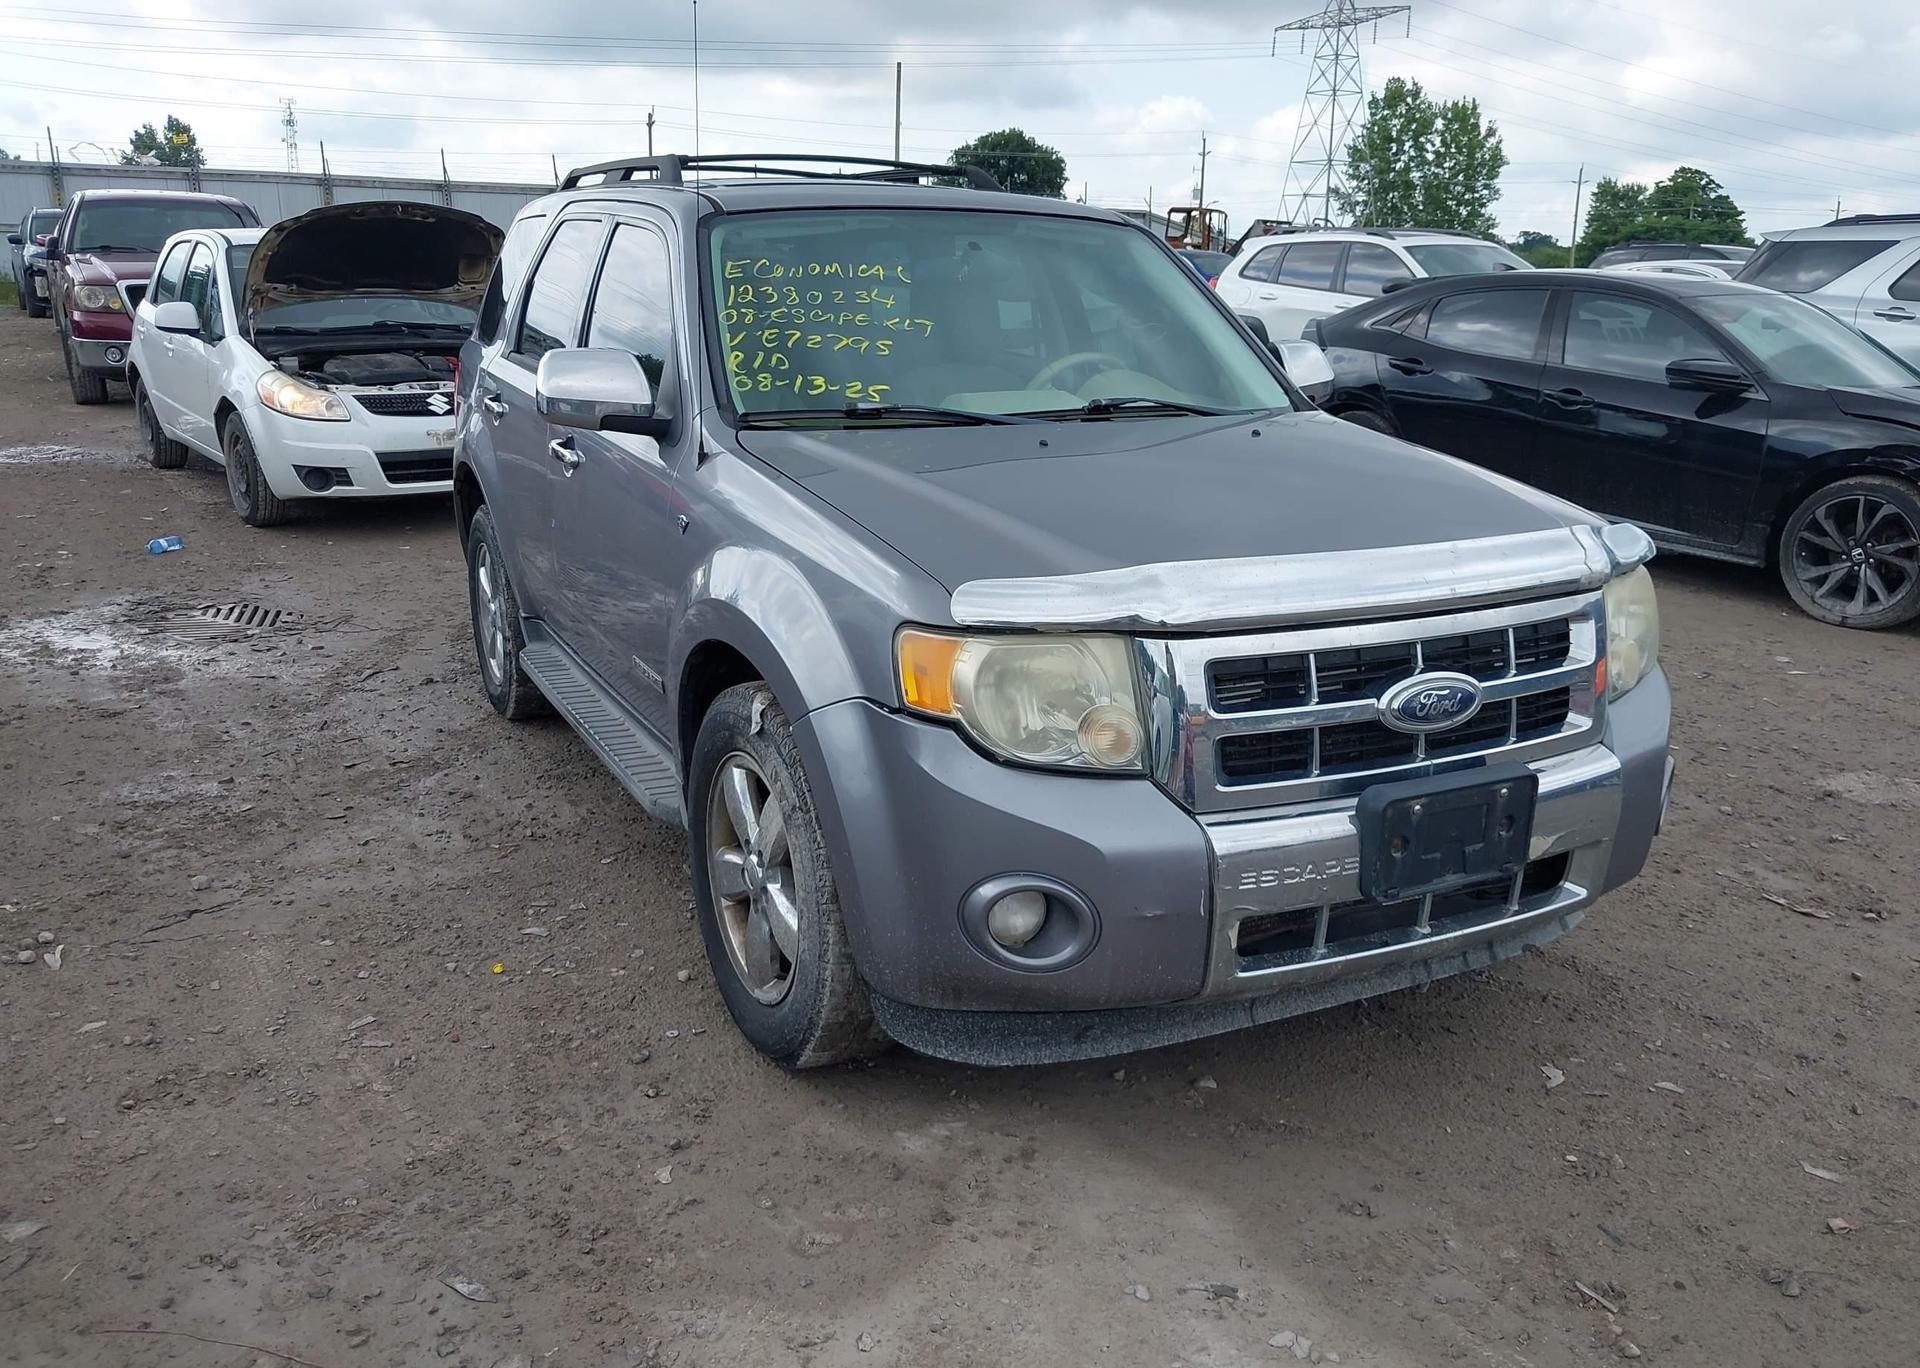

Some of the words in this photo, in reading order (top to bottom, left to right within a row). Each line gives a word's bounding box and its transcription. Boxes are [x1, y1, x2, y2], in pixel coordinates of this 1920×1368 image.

[726, 283, 896, 309] 12380234
[732, 372, 891, 402] 08-13-25
[1416, 689, 1462, 717] Ford
[1238, 857, 1360, 889] ESCAPE
